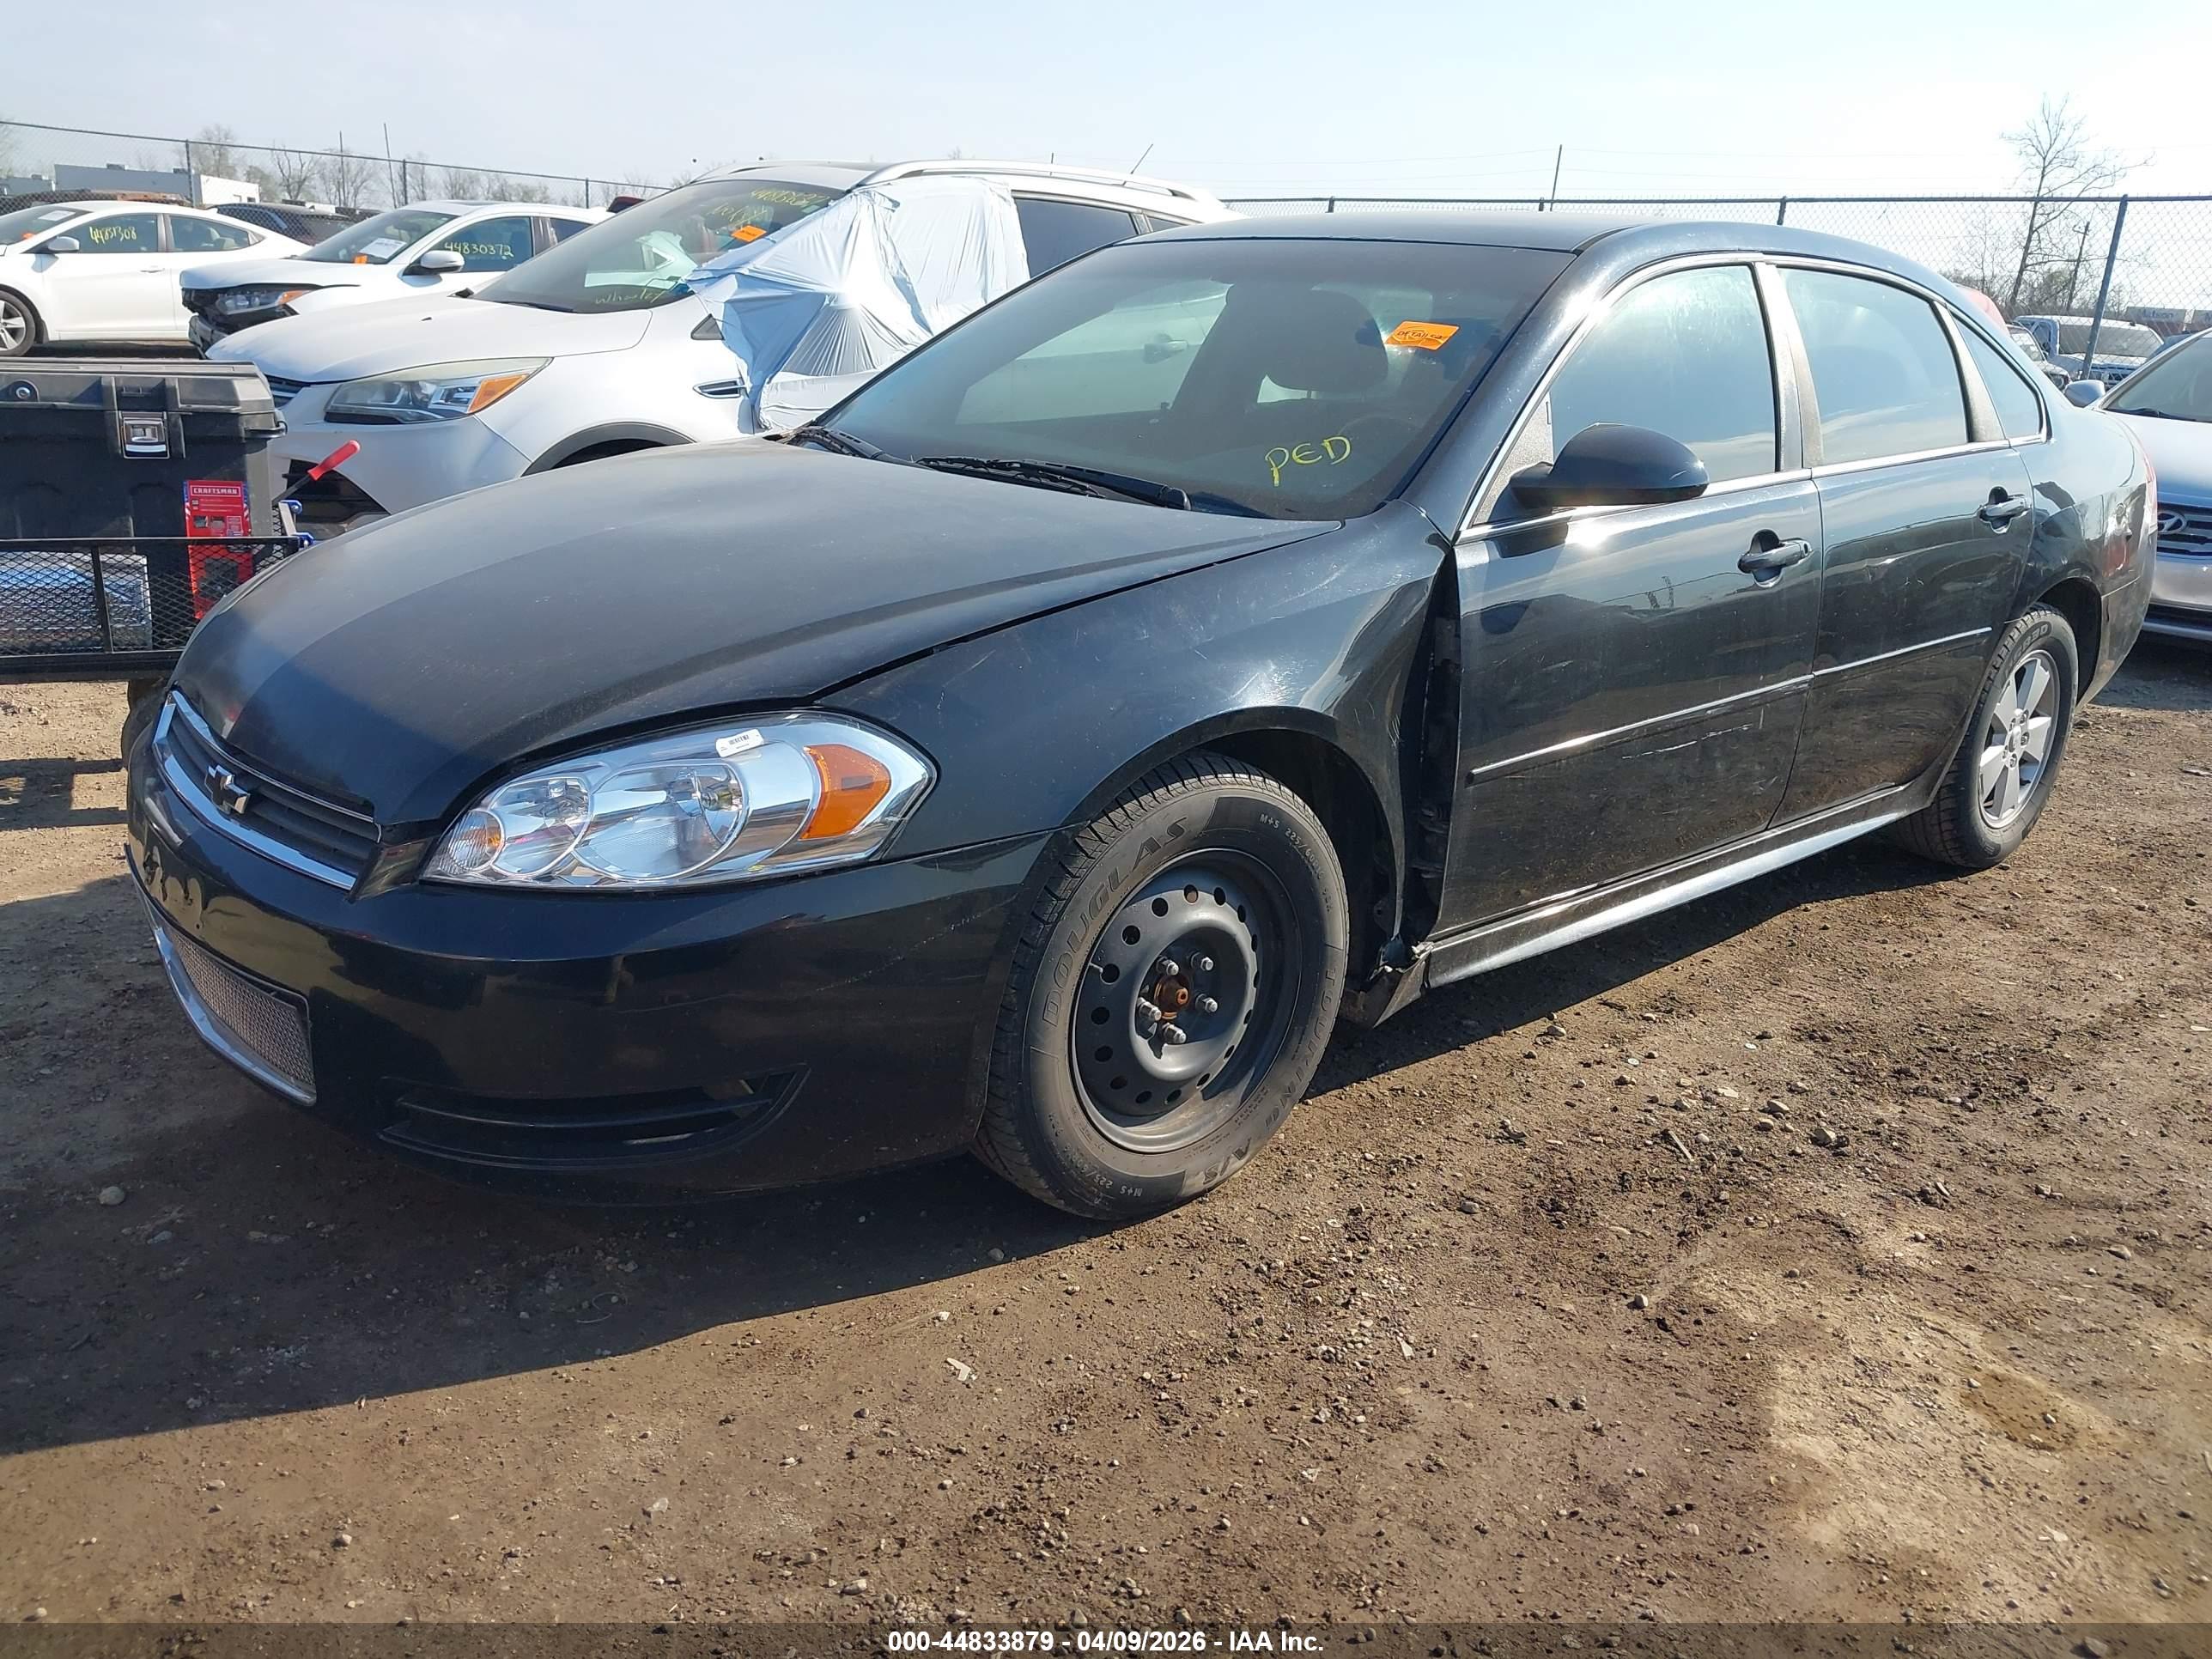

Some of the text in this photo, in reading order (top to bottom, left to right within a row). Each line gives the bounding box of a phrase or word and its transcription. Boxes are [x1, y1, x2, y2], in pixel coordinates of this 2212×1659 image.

[1264, 436, 1351, 487] PED
[193, 487, 238, 495] CRAFTSMAN
[1258, 813, 1281, 830] M+S
[1041, 816, 1188, 1030] DOUGLAS
[1264, 967, 1337, 1134] TOURING
